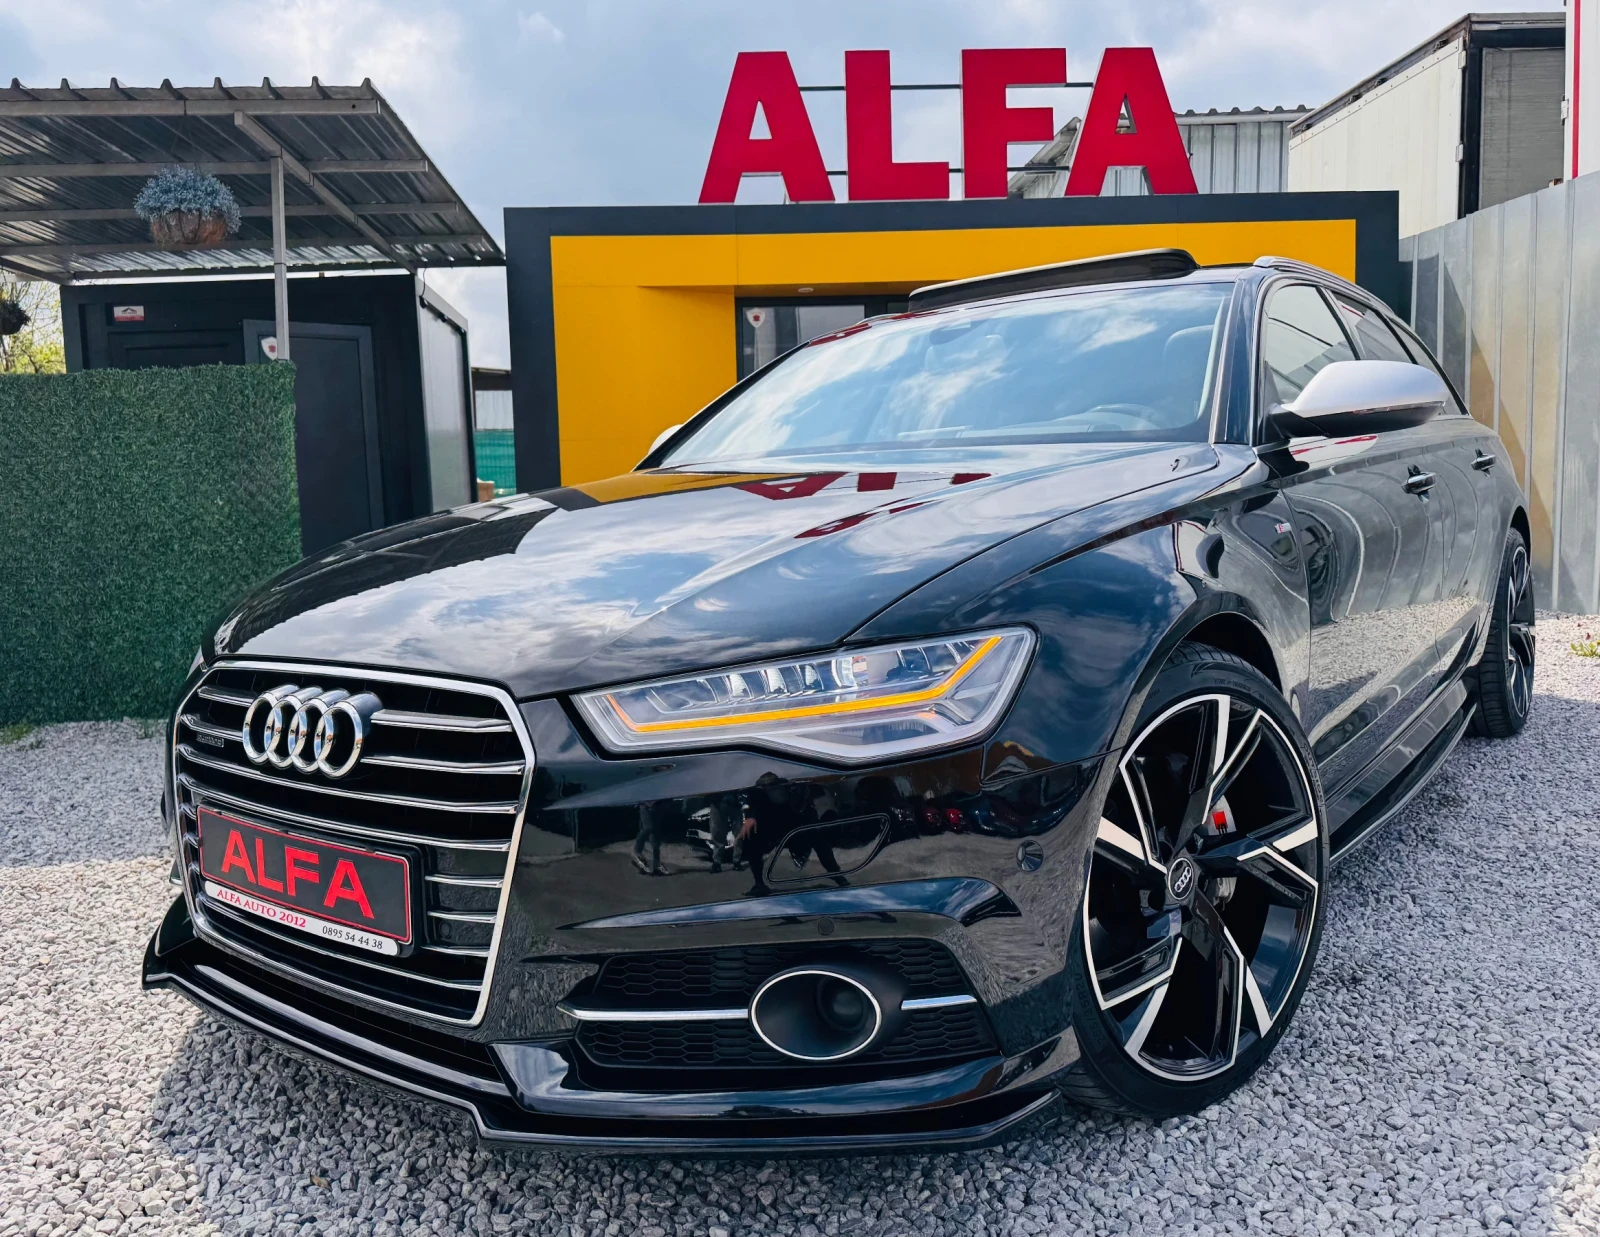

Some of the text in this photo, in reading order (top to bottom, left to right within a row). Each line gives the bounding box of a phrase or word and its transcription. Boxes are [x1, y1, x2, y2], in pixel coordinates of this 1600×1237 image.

[698, 47, 1198, 204] ALFA
[221, 829, 375, 919] ALFA
[217, 889, 306, 928] ALFA AUTO 2012
[322, 926, 383, 950] 0895 54 44 38
